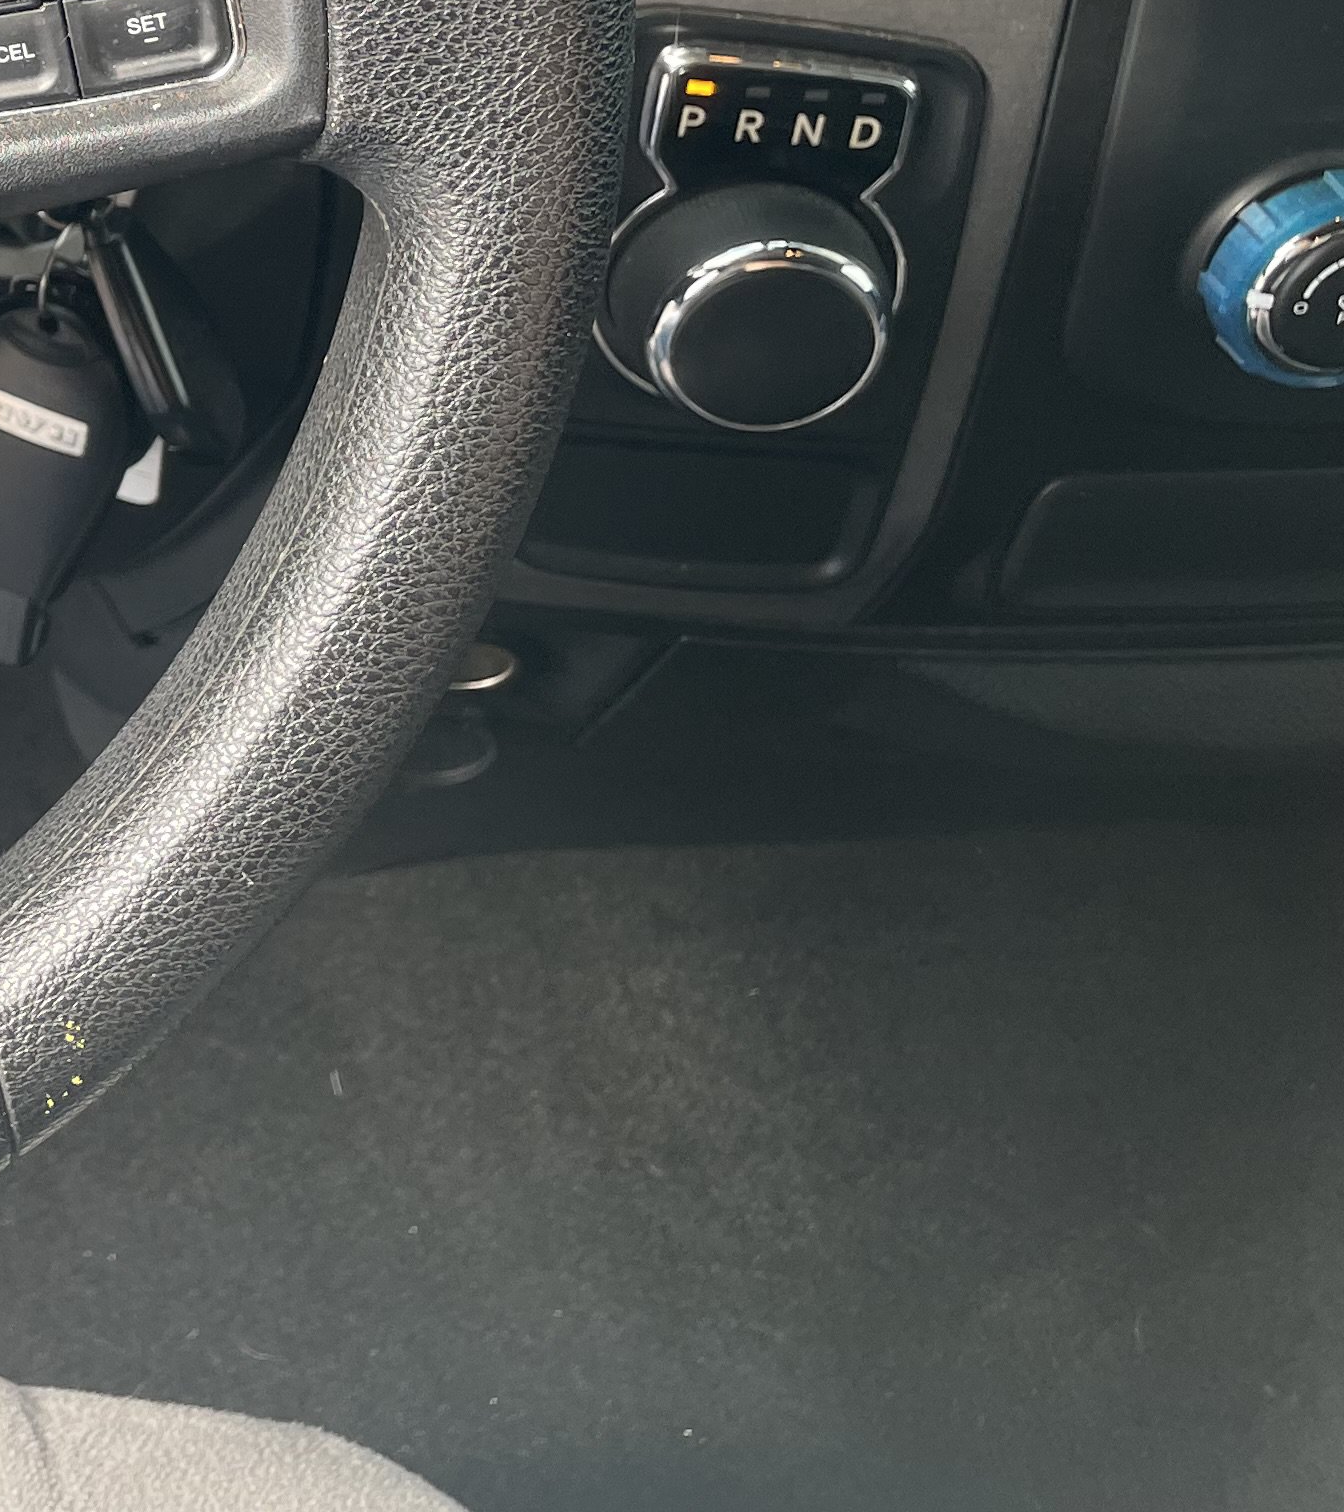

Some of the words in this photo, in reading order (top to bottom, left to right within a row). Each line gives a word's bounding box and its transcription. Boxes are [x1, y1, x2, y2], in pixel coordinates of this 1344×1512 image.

[126, 12, 168, 36] SET
[677, 104, 707, 138] P
[734, 109, 765, 144] R
[790, 112, 826, 147] N
[848, 115, 882, 150] D
